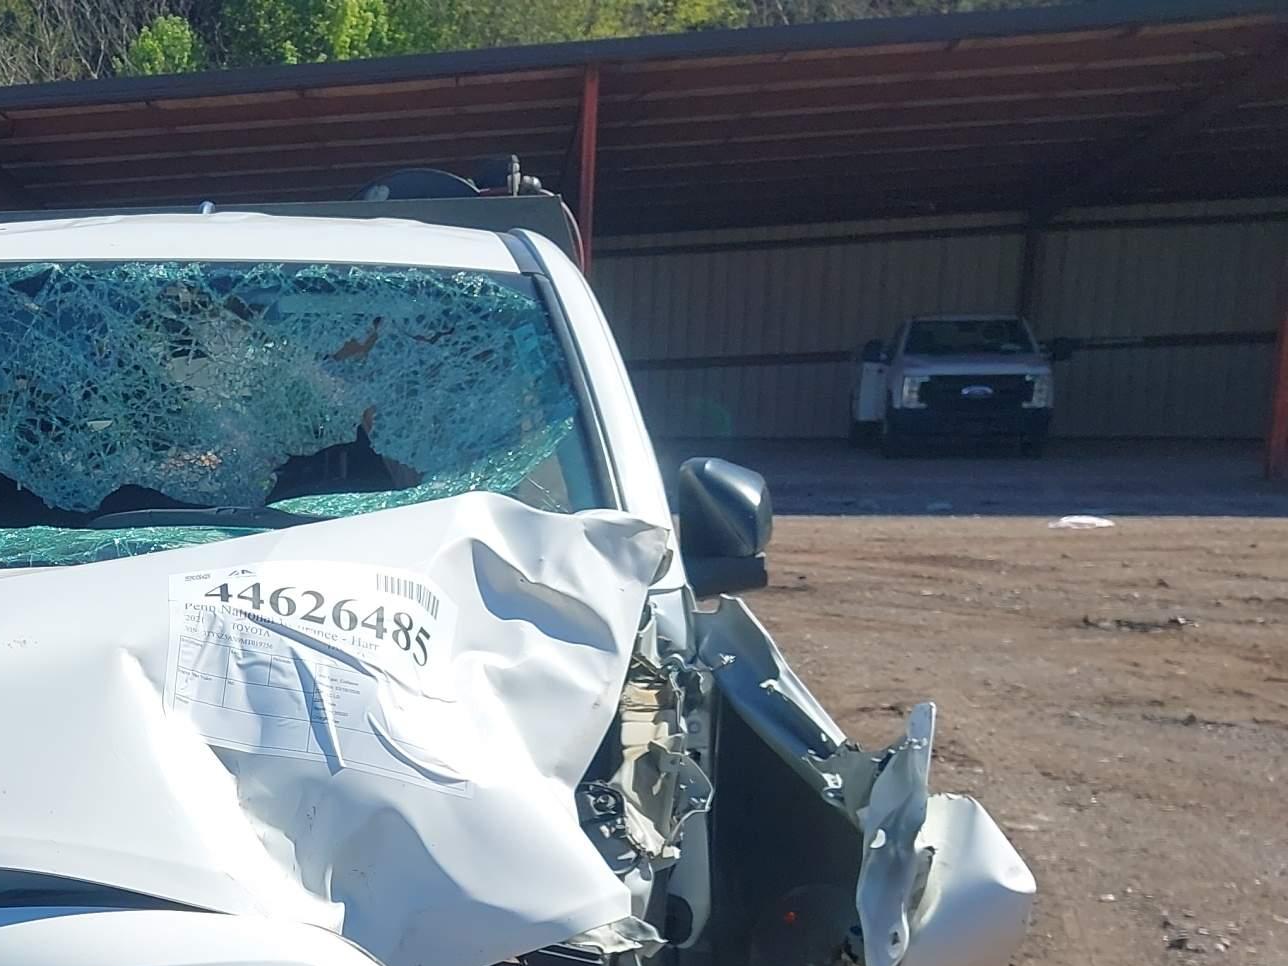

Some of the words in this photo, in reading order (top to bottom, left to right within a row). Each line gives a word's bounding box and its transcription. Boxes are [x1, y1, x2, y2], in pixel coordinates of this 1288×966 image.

[185, 601, 217, 617] Penn
[204, 582, 432, 667] 44626485
[231, 623, 271, 638] TOYOTA
